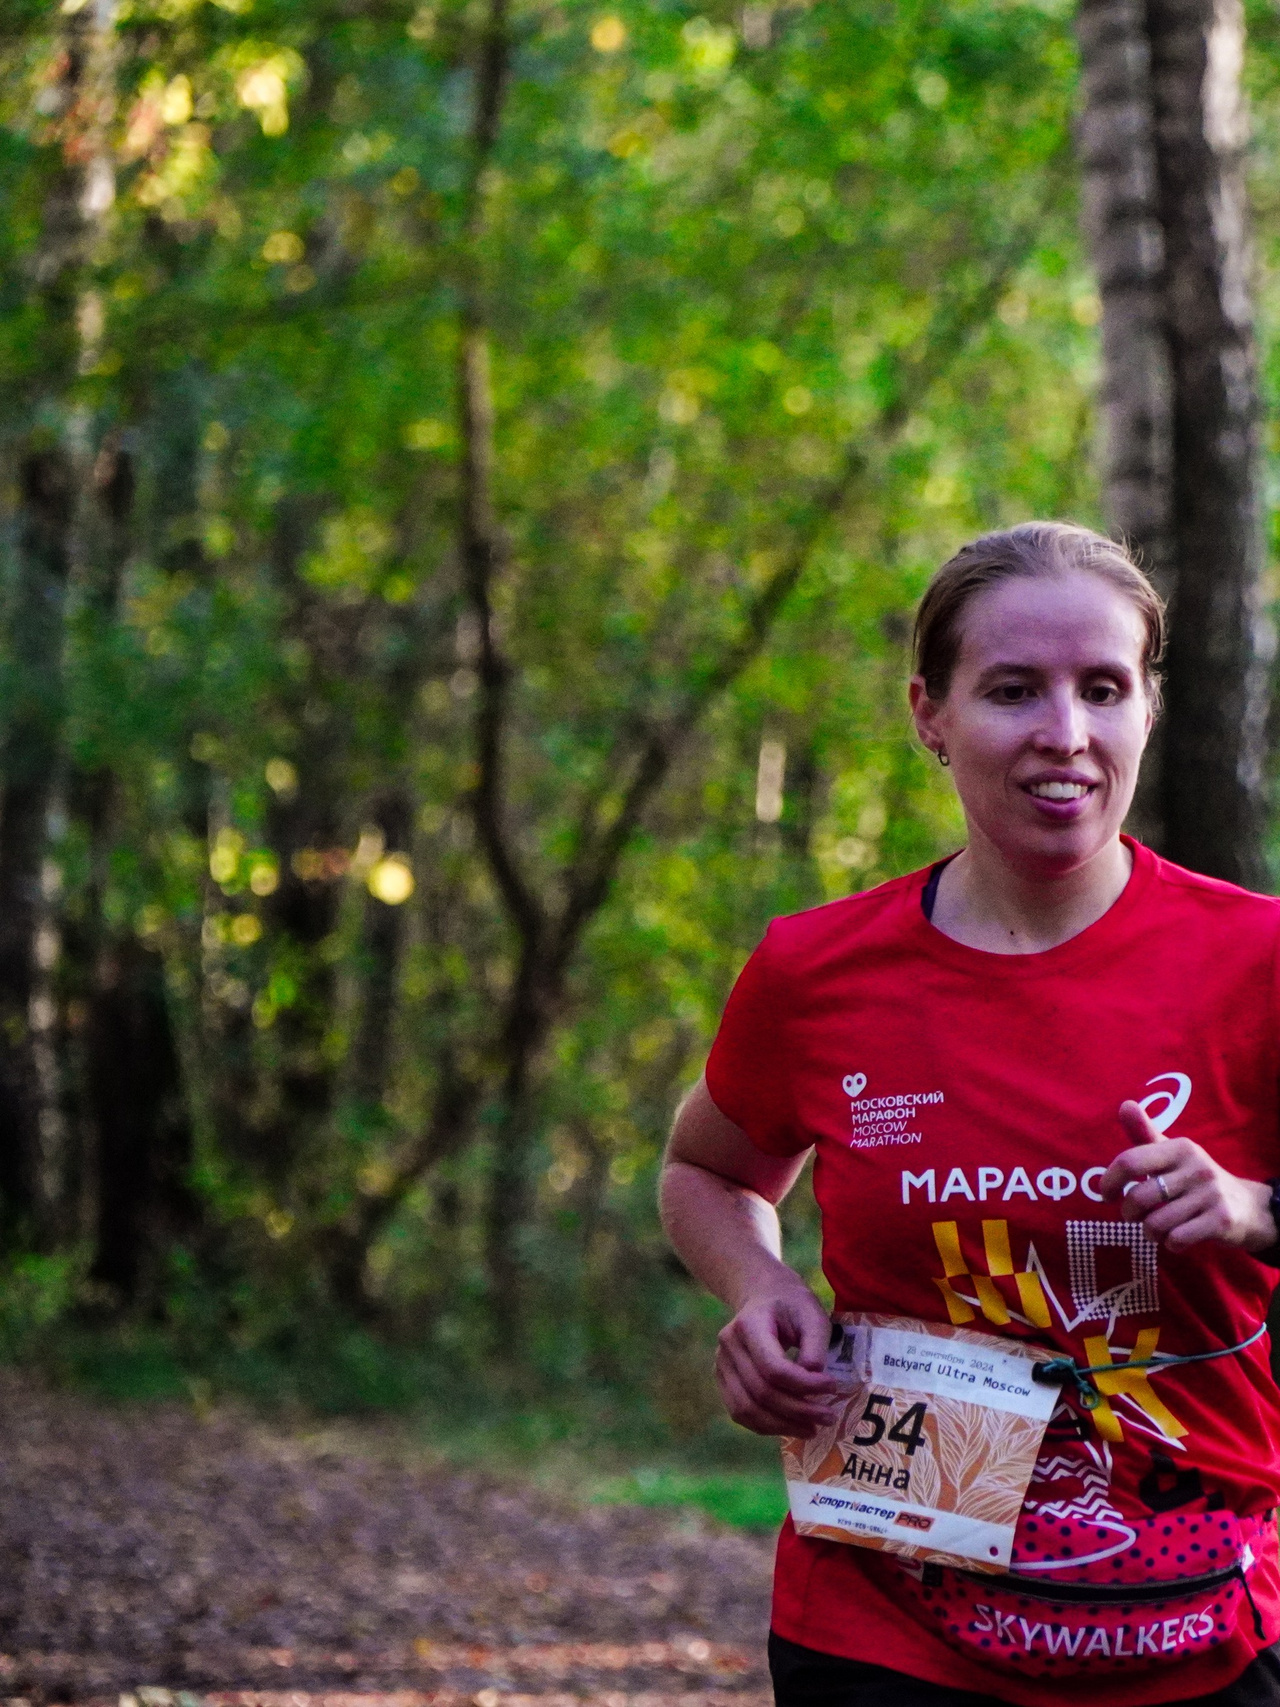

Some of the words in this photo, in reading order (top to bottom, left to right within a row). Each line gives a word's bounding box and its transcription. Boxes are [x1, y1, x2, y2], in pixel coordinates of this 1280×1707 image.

[851, 1090, 944, 1112] МОСКОВСКИЙ
[852, 1107, 916, 1125] МАРАФОН
[850, 1132, 922, 1148] MARATHON
[853, 1121, 907, 1138] MOSCOW
[902, 1166, 1140, 1205] МАРАФО
[883, 1354, 932, 1373] Backyard
[937, 1364, 976, 1384] Ultra
[982, 1376, 1031, 1397] Moscow
[970, 1359, 994, 1373] 2024
[852, 1394, 928, 1456] 54
[840, 1454, 911, 1491] Анна
[896, 1512, 932, 1530] PRO
[973, 1603, 1214, 1657] SKYWALKERS
